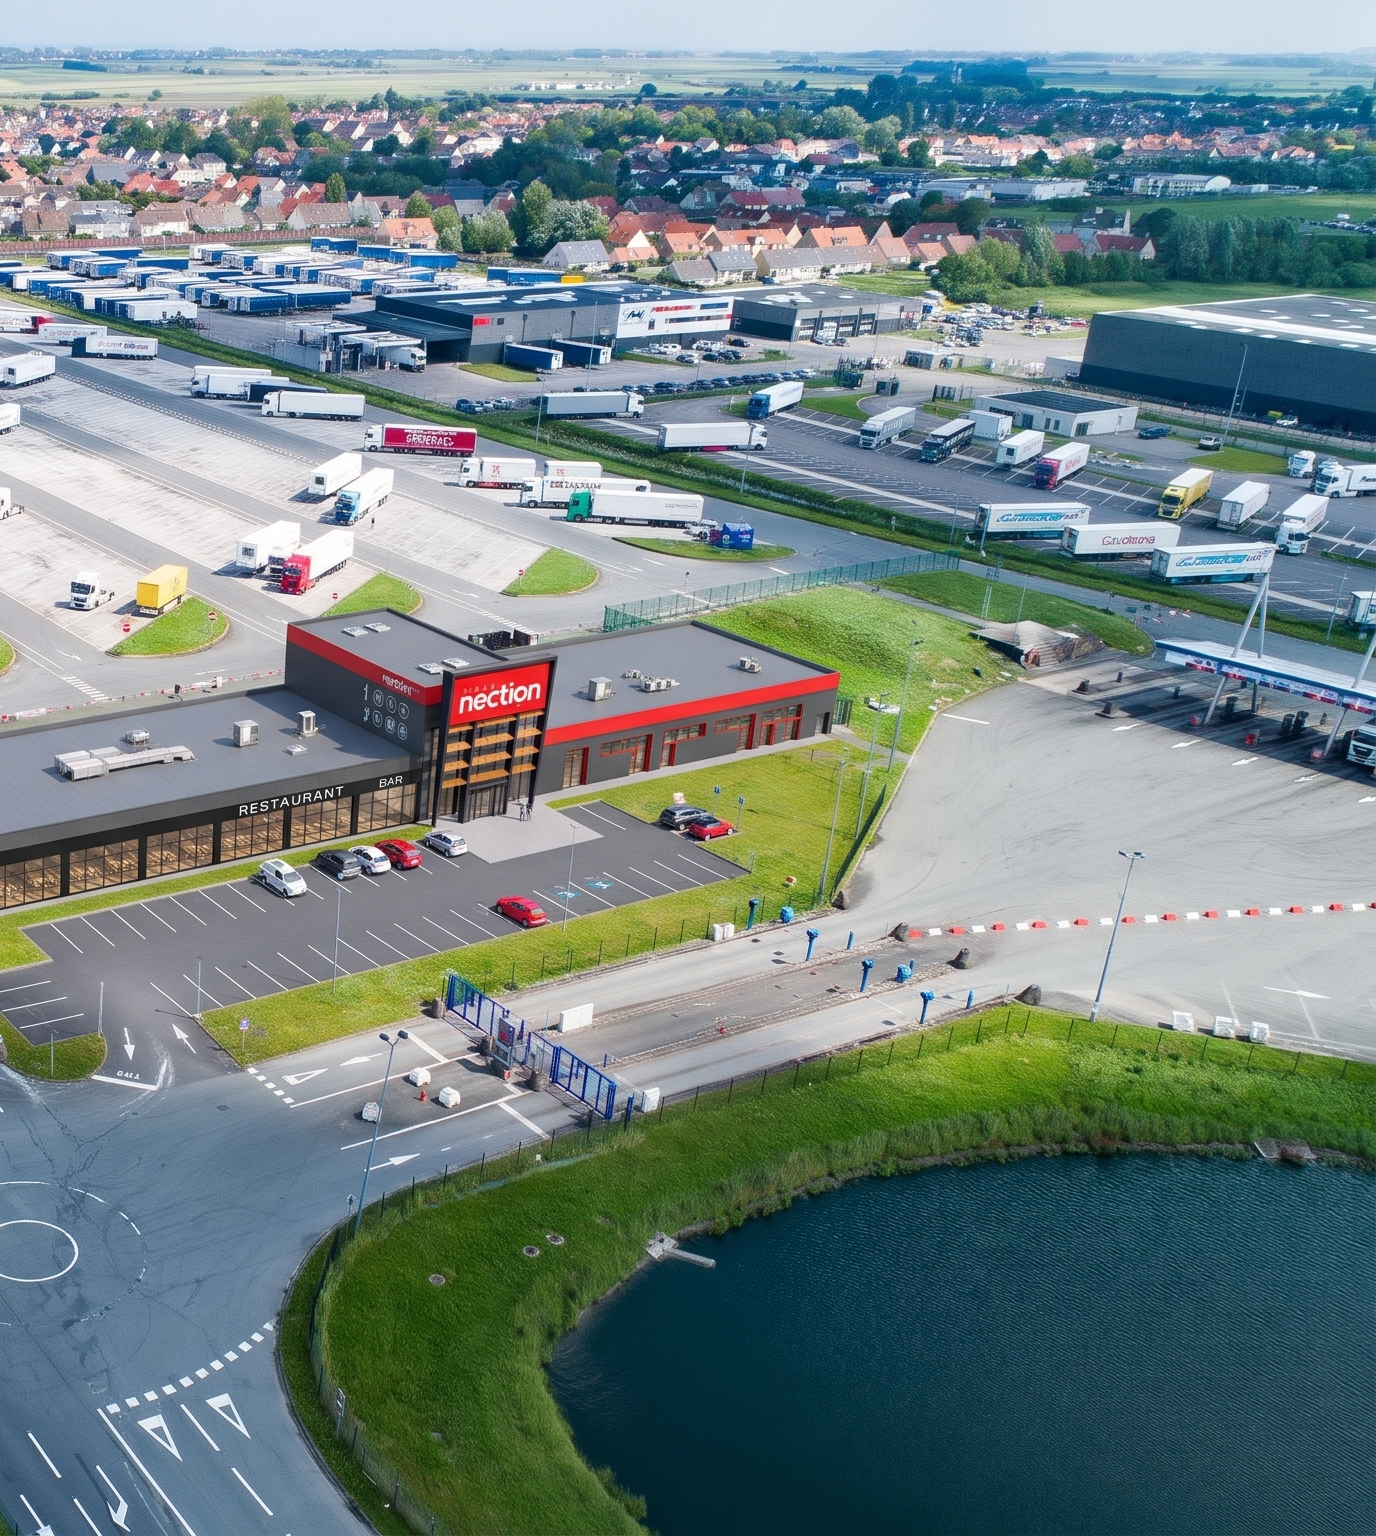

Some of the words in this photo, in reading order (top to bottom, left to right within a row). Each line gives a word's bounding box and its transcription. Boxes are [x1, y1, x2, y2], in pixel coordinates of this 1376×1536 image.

[458, 681, 541, 715] nection
[239, 786, 344, 816] RESTAURANT
[379, 775, 403, 788] BAR
